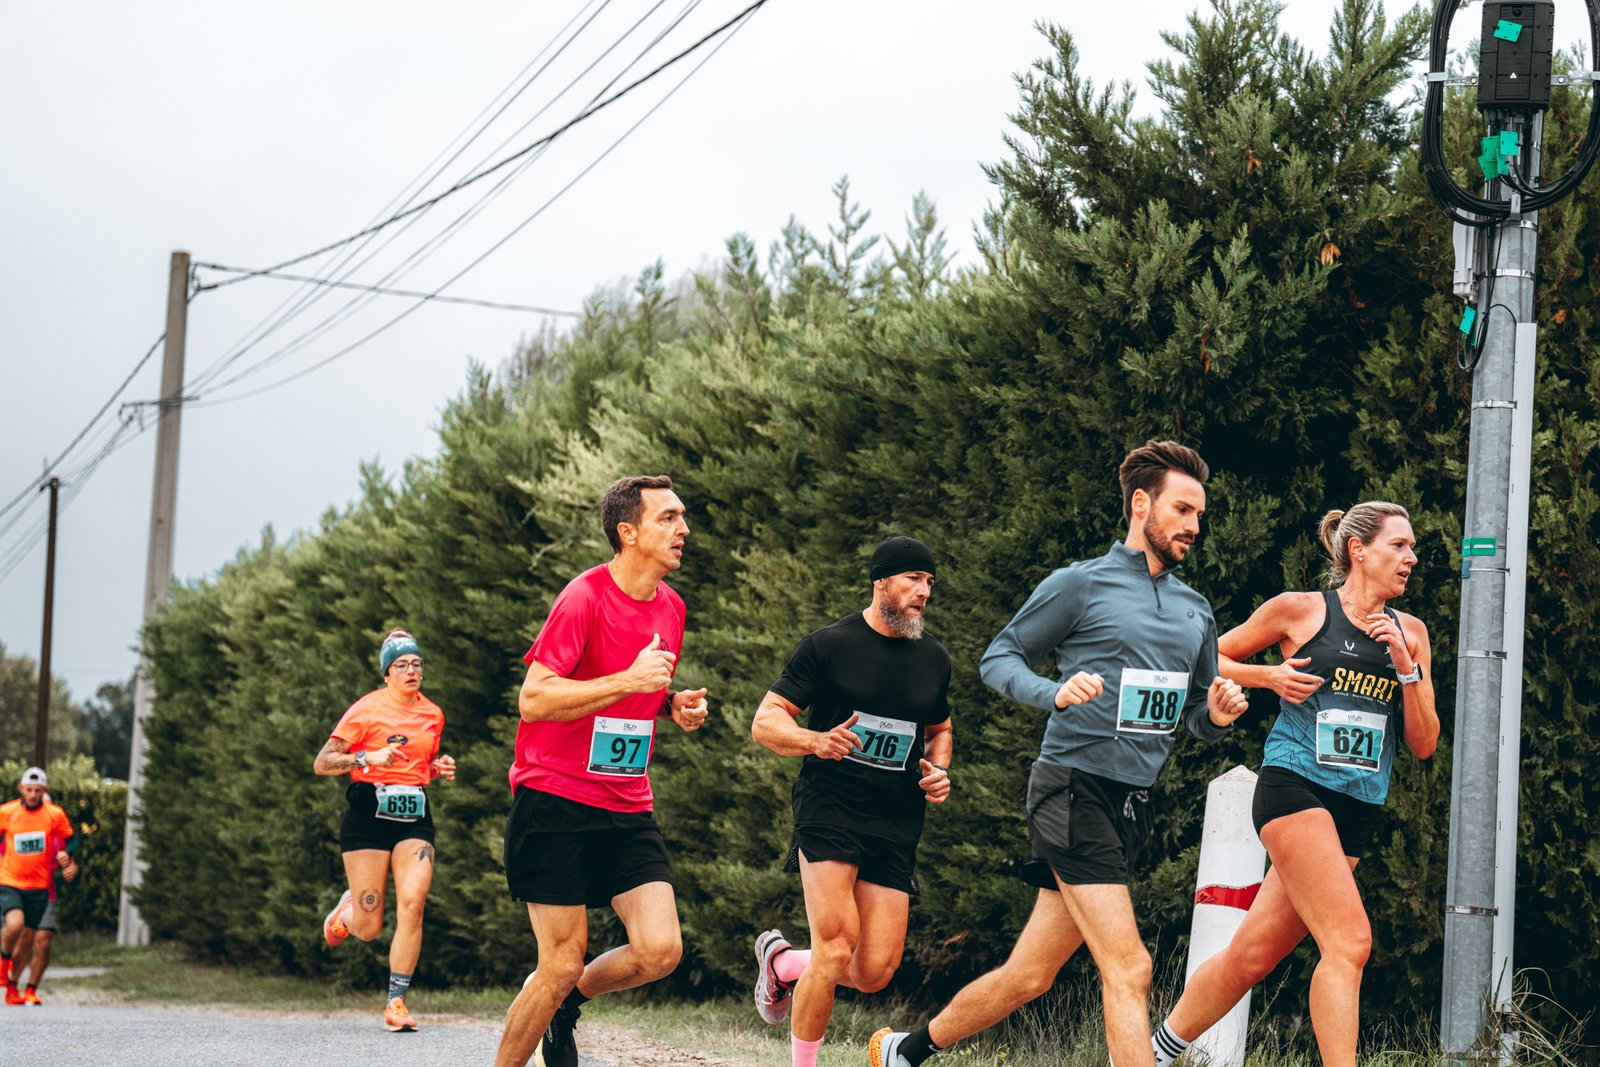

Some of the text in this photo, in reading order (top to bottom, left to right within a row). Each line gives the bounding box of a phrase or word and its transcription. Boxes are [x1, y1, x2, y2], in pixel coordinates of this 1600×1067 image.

[1331, 667, 1398, 702] SMART
[1137, 689, 1178, 721] 788
[610, 737, 642, 764] 97
[861, 730, 899, 759] 716
[1333, 726, 1373, 758] 621
[387, 795, 417, 813] 635
